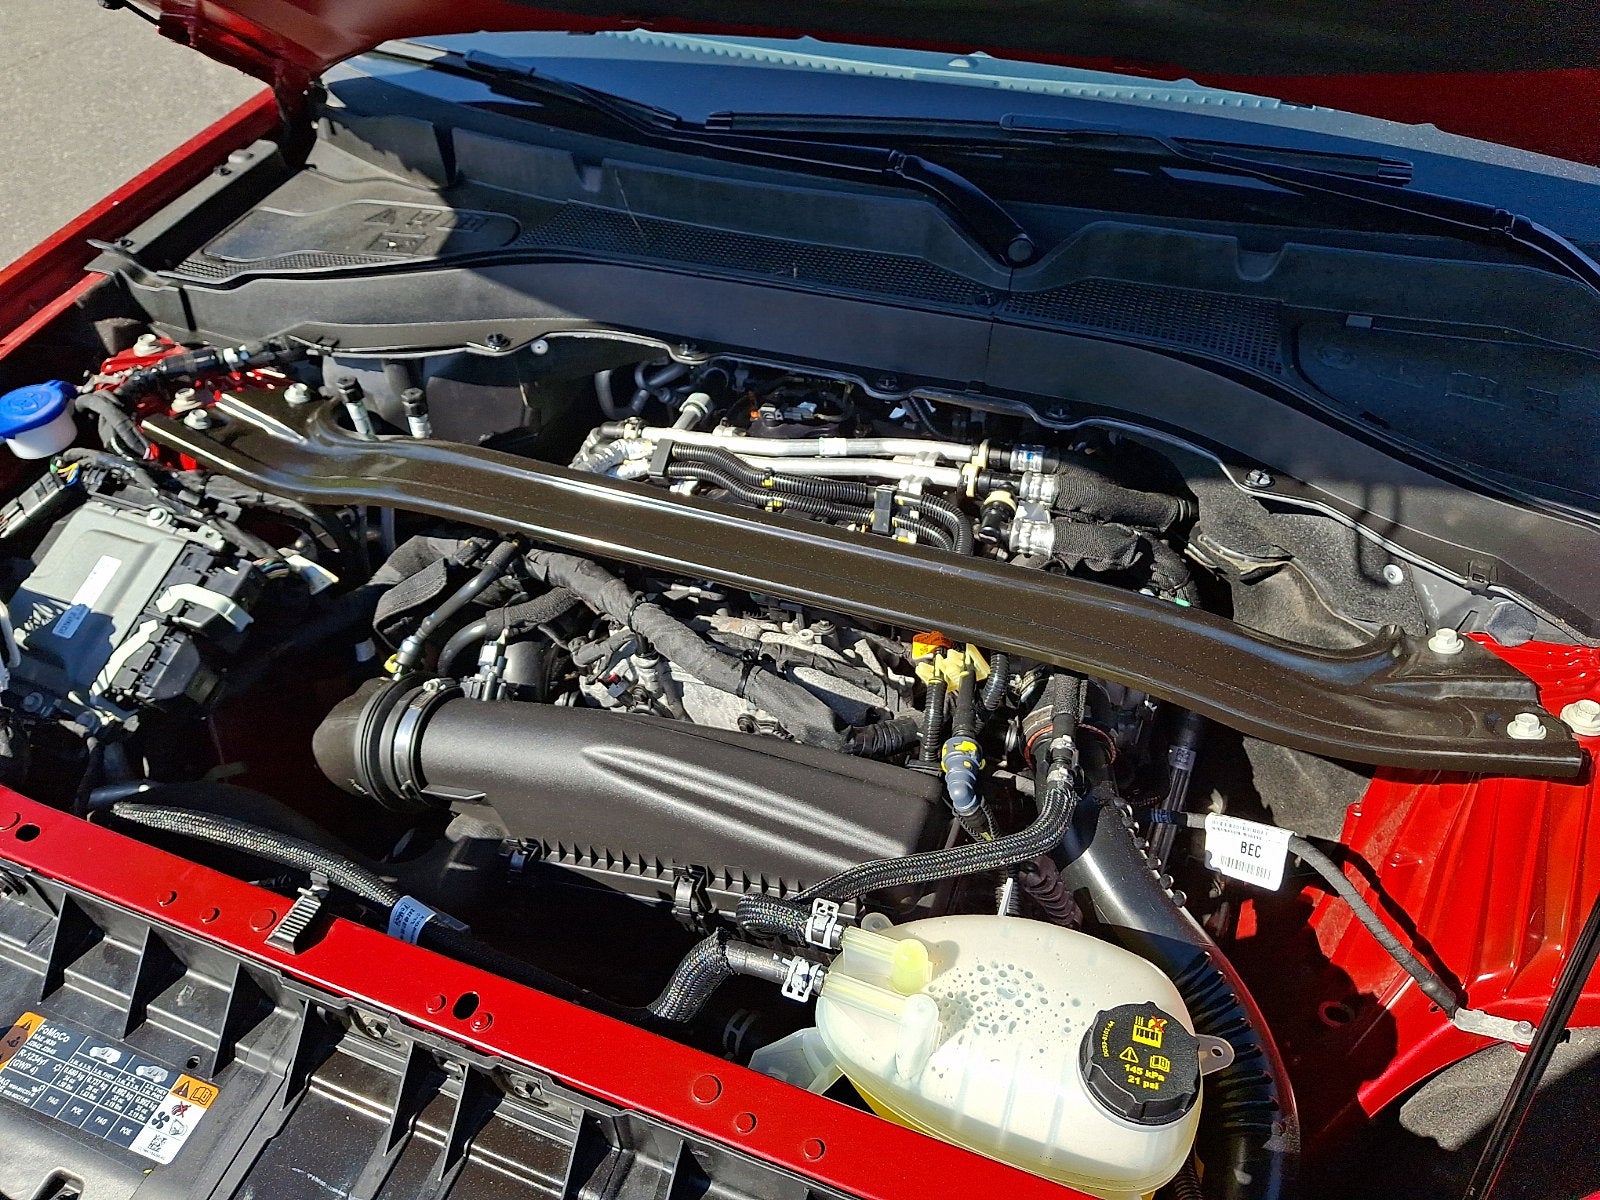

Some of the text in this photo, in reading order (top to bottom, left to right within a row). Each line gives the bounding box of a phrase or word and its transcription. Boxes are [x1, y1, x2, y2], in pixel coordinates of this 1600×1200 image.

[1240, 841, 1262, 858] BEC
[38, 1024, 71, 1043] FoMoCo
[1124, 1063, 1165, 1082] 145 kPa
[1127, 1075, 1159, 1091] 21 psi
